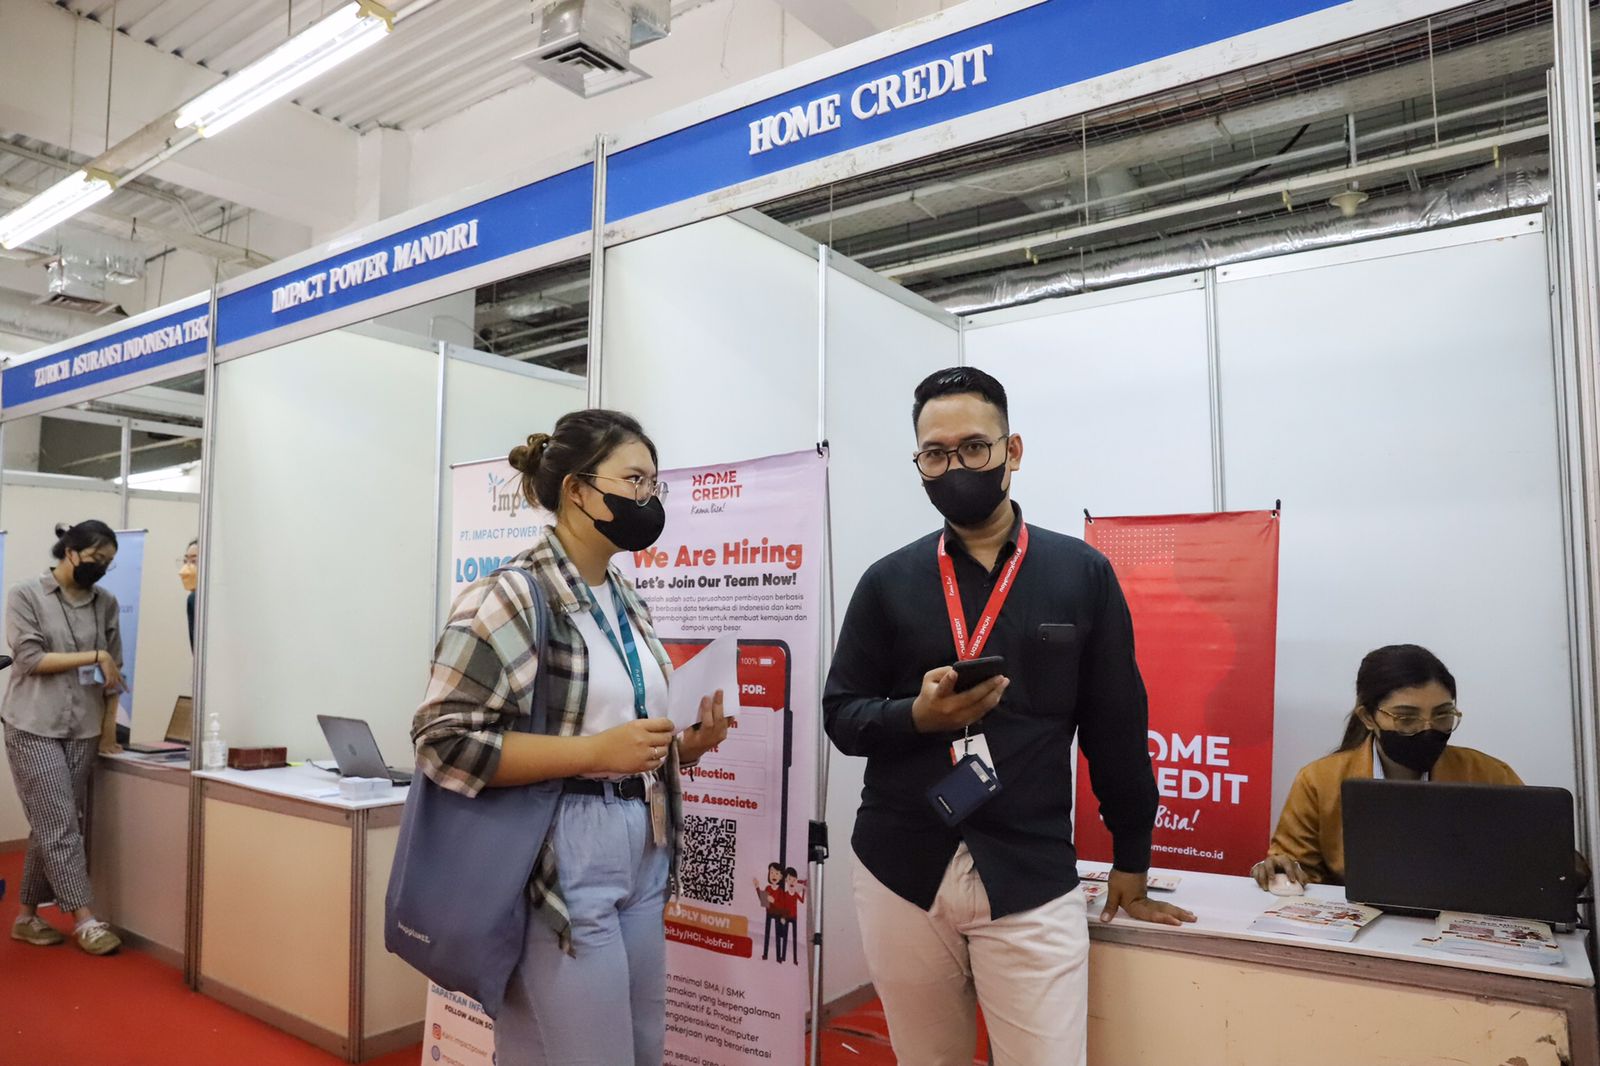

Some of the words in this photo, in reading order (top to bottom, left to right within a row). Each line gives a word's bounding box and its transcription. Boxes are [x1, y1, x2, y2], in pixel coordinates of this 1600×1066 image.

[749, 93, 841, 155] HOME
[851, 44, 993, 120] CREDIT
[272, 272, 327, 313] IMPACT
[329, 251, 388, 294] POWER
[392, 219, 478, 272] MANDIRI
[72, 343, 122, 377] ASURANSI
[123, 324, 183, 361] INDONESIA
[183, 314, 209, 343] TBK
[692, 470, 737, 486] HOME
[692, 484, 743, 501] CREDIT
[472, 528, 504, 540] IMPACT
[507, 526, 537, 539] POWER
[633, 546, 669, 569] We
[674, 545, 717, 568] Are
[723, 536, 803, 570] Hiring
[668, 575, 695, 588] Join
[698, 576, 721, 588] Our
[724, 574, 760, 587] Team
[763, 572, 797, 586] Now!
[697, 594, 733, 605] perusahaan
[735, 593, 773, 604] pembiayaan
[775, 593, 804, 601] berbasis
[699, 604, 731, 612] terkemuka
[771, 603, 784, 611] dan
[786, 603, 802, 611] kami
[710, 613, 728, 621] untuk
[729, 613, 759, 621] membuat
[760, 612, 793, 622] kemajuan
[795, 613, 807, 621] dan
[979, 615, 992, 636] HOME
[681, 624, 706, 633] dampak
[707, 624, 722, 633] yang
[723, 624, 742, 632] besar.
[954, 617, 964, 639] CREDIT
[969, 635, 983, 657] CREDIT
[741, 657, 758, 665] 100%
[742, 684, 766, 695] FOR:
[1147, 730, 1230, 767] OME
[680, 766, 736, 781] Collection
[1158, 767, 1249, 805] EDIT
[702, 793, 758, 810] Associate
[1151, 844, 1224, 860] mecredit.co.id
[700, 915, 731, 929] NOW!
[673, 974, 703, 988] minimal
[704, 980, 720, 992] SMA
[726, 987, 746, 999] SMK
[444, 1004, 467, 1019] FOLLOW
[698, 994, 716, 1007] yang
[717, 997, 781, 1021] berpengalaman
[706, 1006, 712, 1016] &
[713, 1008, 743, 1025] Proaktif
[665, 1011, 720, 1031] engoperasikan
[721, 1025, 760, 1042] Komputer
[665, 1023, 703, 1039] pekerjaan
[704, 1033, 723, 1048] yang
